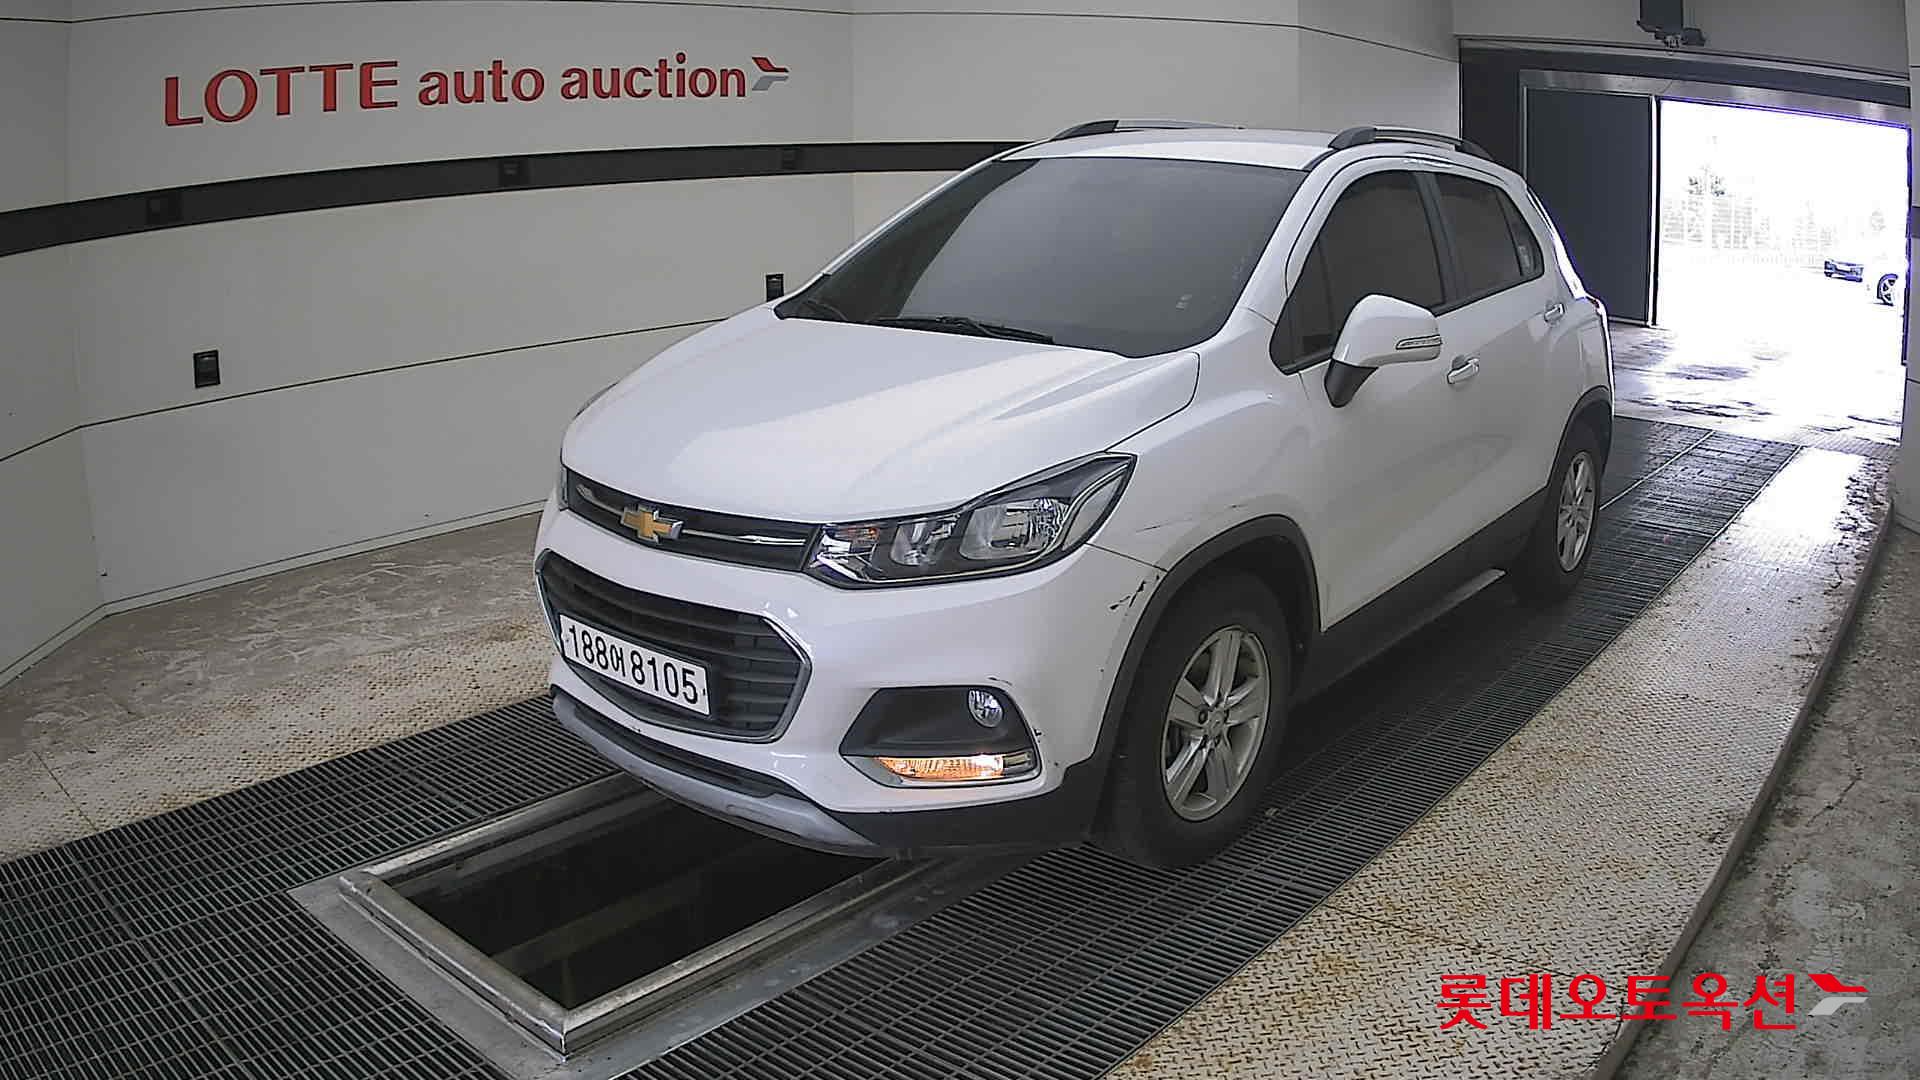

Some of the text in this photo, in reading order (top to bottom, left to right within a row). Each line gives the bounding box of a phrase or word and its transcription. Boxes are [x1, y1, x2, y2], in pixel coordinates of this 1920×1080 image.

[165, 52, 747, 126] LOTTE auto auction
[630, 650, 698, 704] 8105
